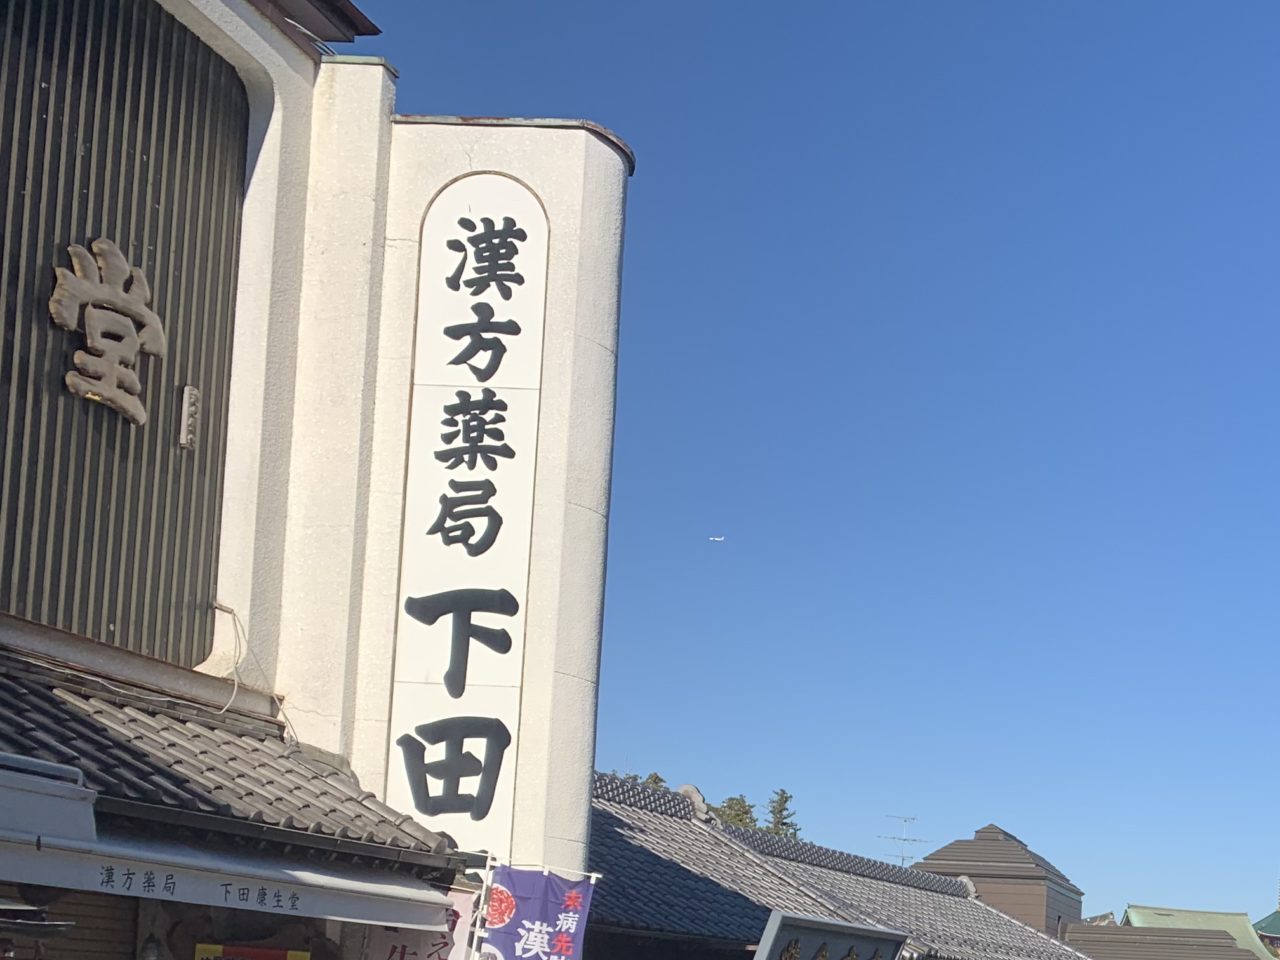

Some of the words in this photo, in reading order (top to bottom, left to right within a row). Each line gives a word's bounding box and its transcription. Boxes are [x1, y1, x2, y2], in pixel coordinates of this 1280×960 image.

[48, 236, 166, 427] 堂
[426, 215, 528, 558] 漢方薬局
[395, 587, 520, 821] 下田
[100, 866, 176, 896] 漢方薬局
[219, 883, 301, 911] 下田康生堂
